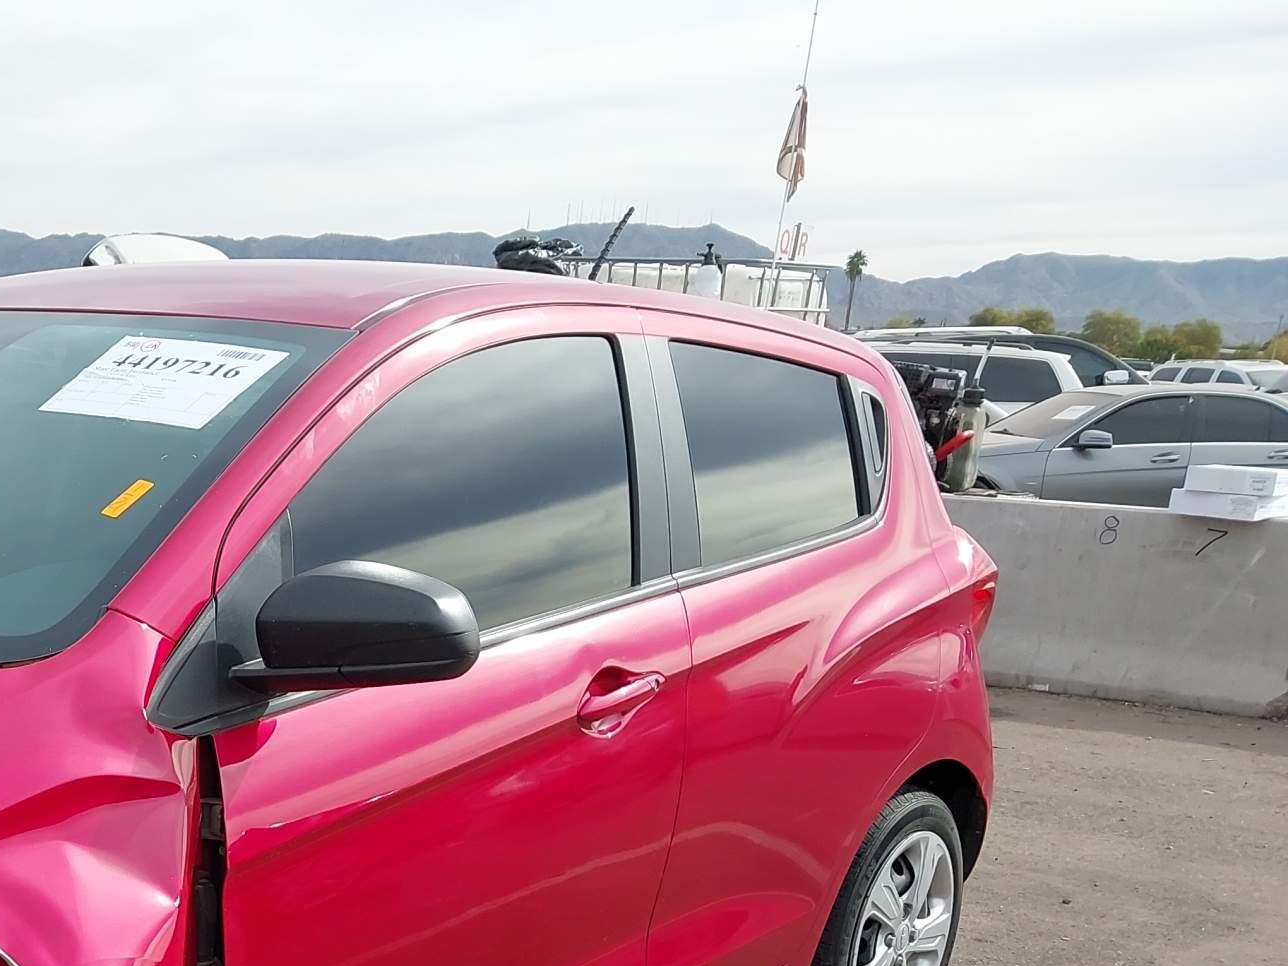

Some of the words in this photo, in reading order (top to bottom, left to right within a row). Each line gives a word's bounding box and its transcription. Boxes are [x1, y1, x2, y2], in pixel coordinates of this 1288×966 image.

[112, 353, 249, 379] 44197216
[1099, 515, 1120, 545] 8
[1195, 528, 1229, 557] 7
